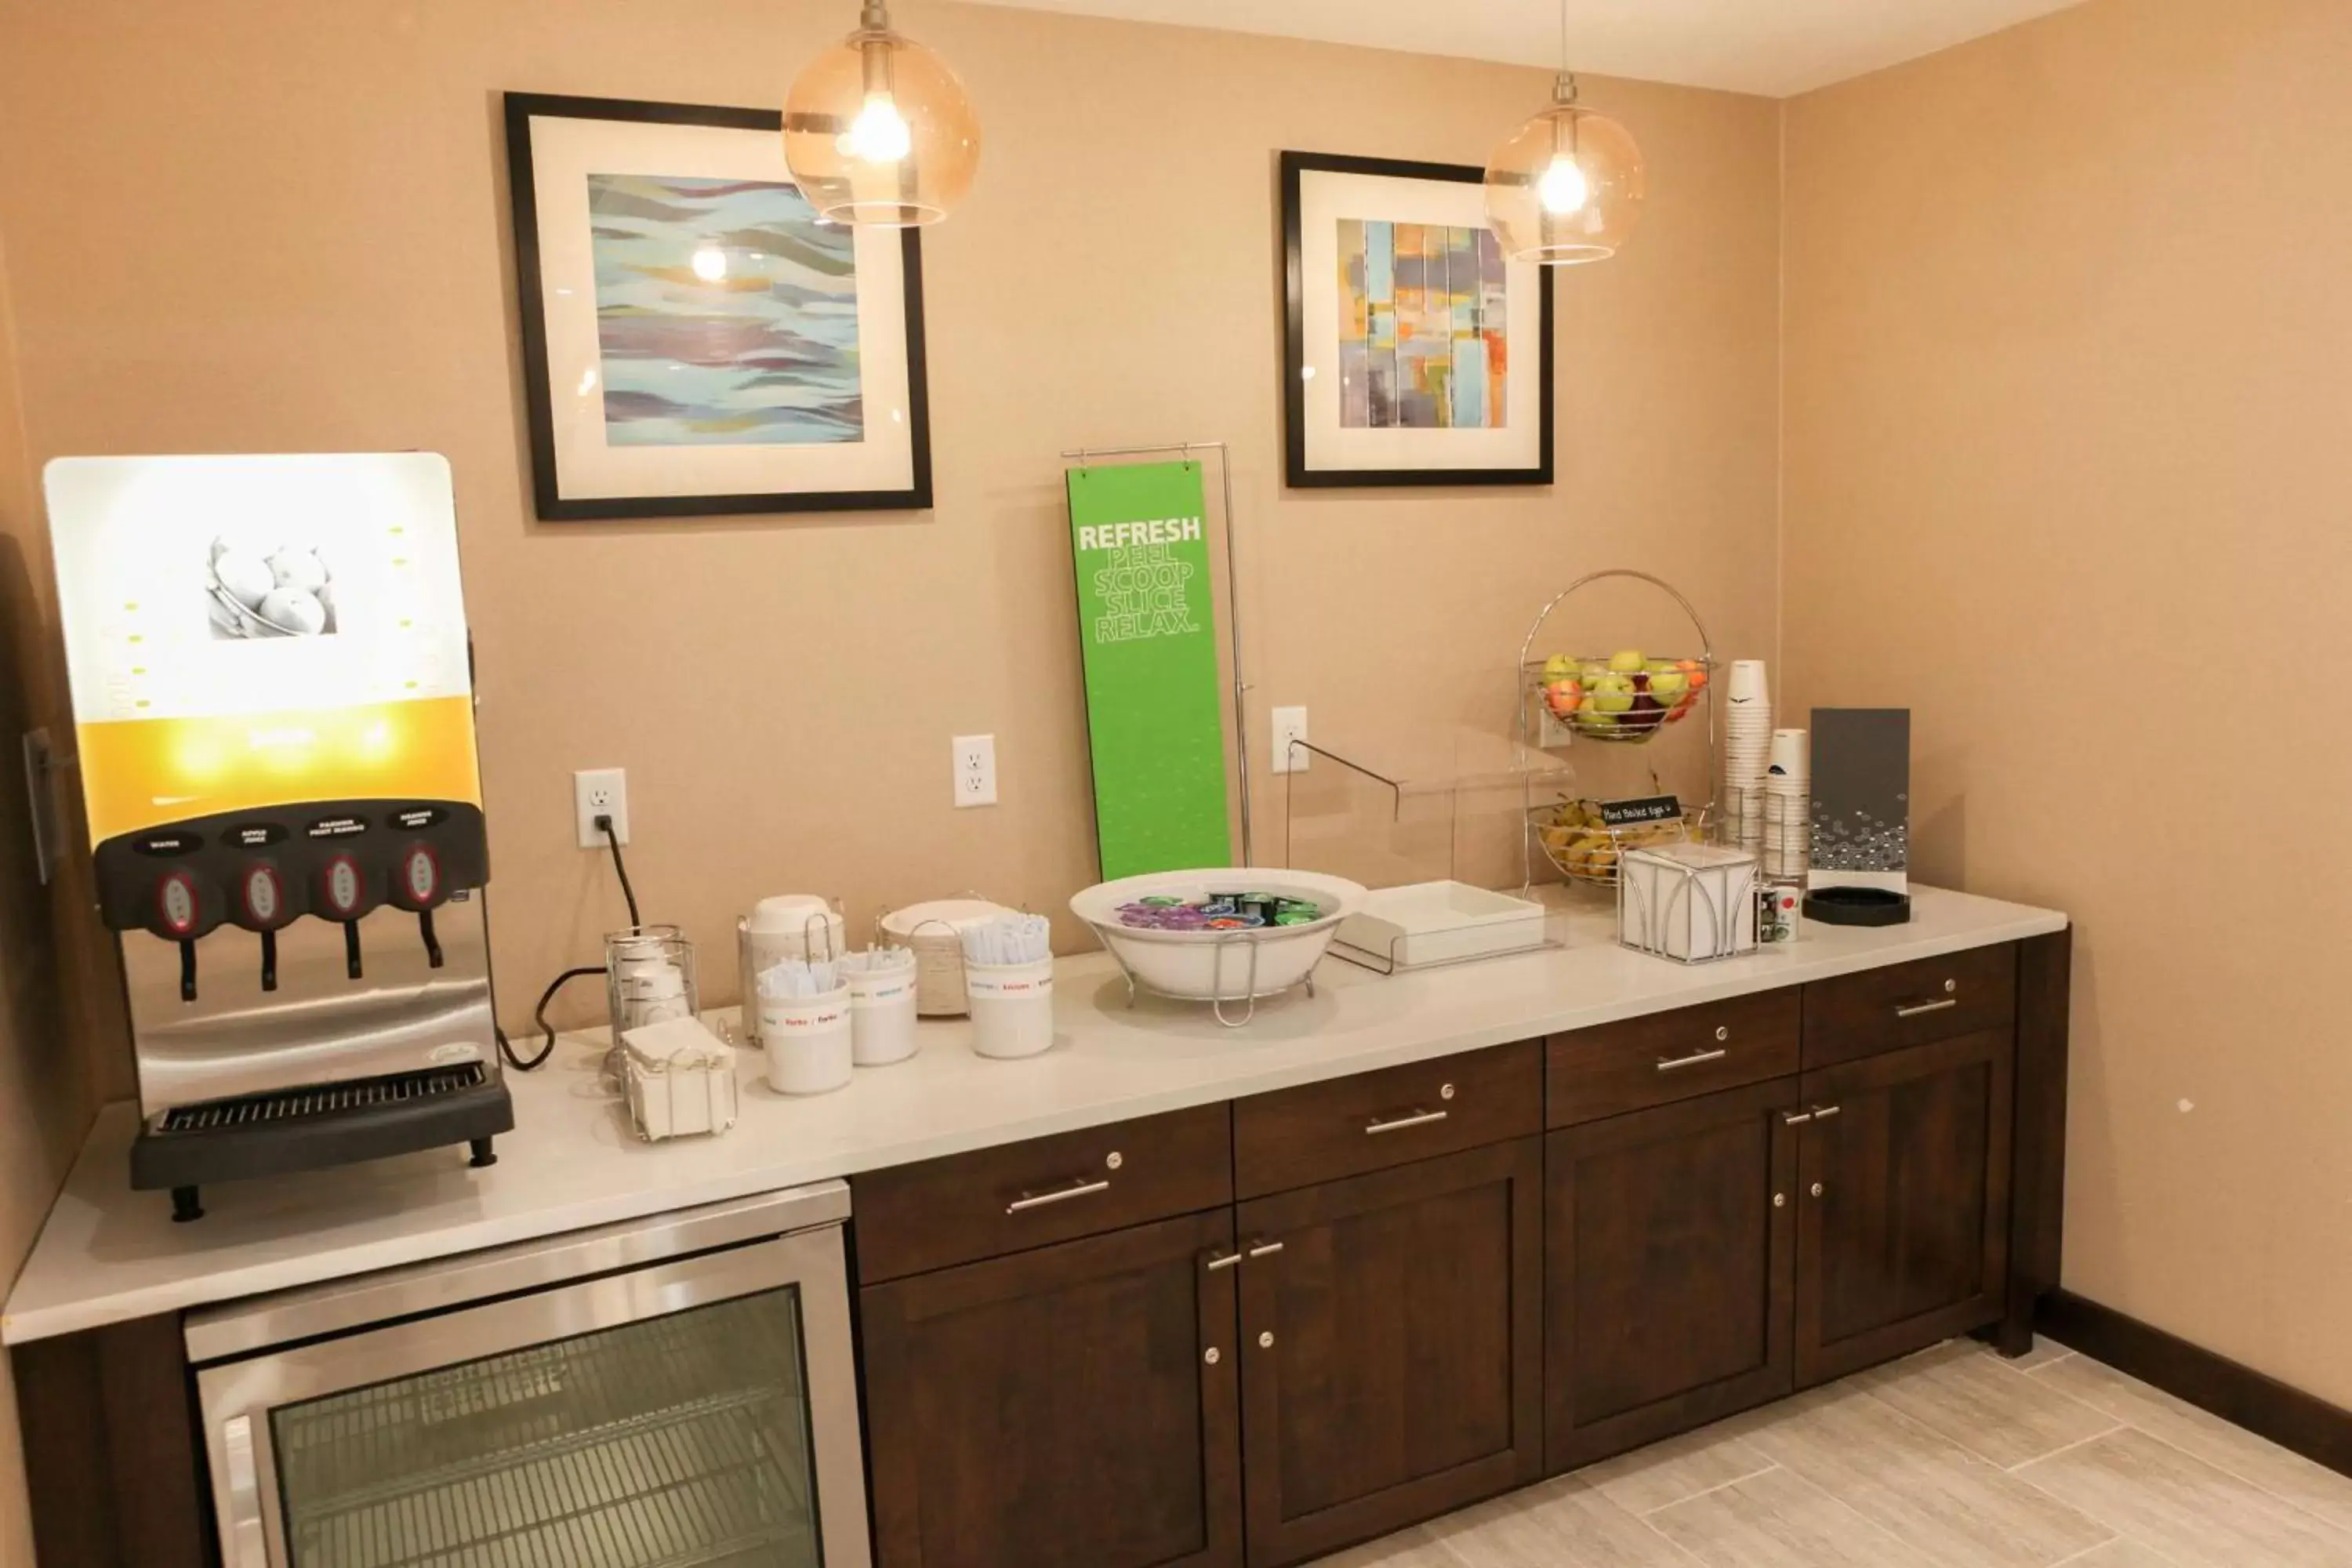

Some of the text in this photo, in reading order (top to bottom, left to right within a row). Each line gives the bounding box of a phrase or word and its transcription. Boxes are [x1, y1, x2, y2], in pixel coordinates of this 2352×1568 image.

[1079, 517, 1201, 550] REFRESH
[1108, 543, 1177, 570] PEEL
[1094, 563, 1193, 597] SCOOP
[1105, 589, 1186, 618] SLICE
